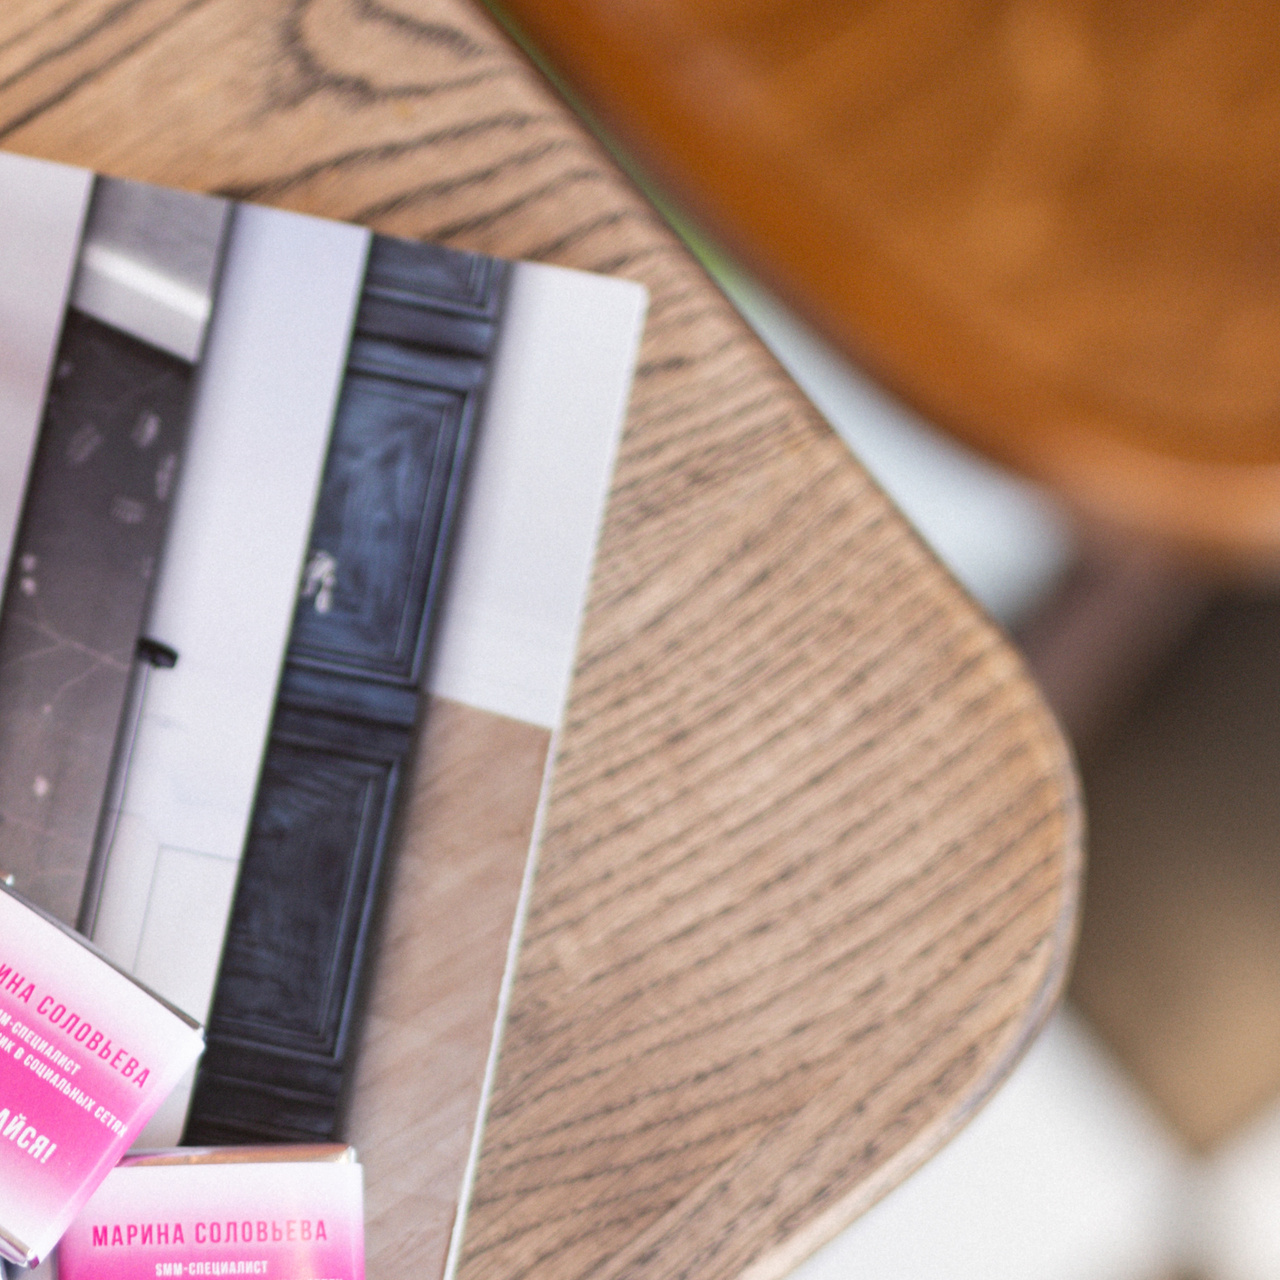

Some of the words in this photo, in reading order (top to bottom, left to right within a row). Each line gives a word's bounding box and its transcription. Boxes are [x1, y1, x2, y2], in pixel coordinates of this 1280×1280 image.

[34, 994, 153, 1089] СОЛОВЬЕВА
[11, 1047, 24, 1062] В
[21, 1054, 95, 1113] СОЦИАЛЬНЫХ
[92, 1106, 129, 1138] СЕТЯХ
[91, 1223, 185, 1246] МАРИНА
[194, 1219, 327, 1244] СОЛОВЬЕВА
[155, 1260, 268, 1276] SMM-СПЕЦИАЛИСТ
